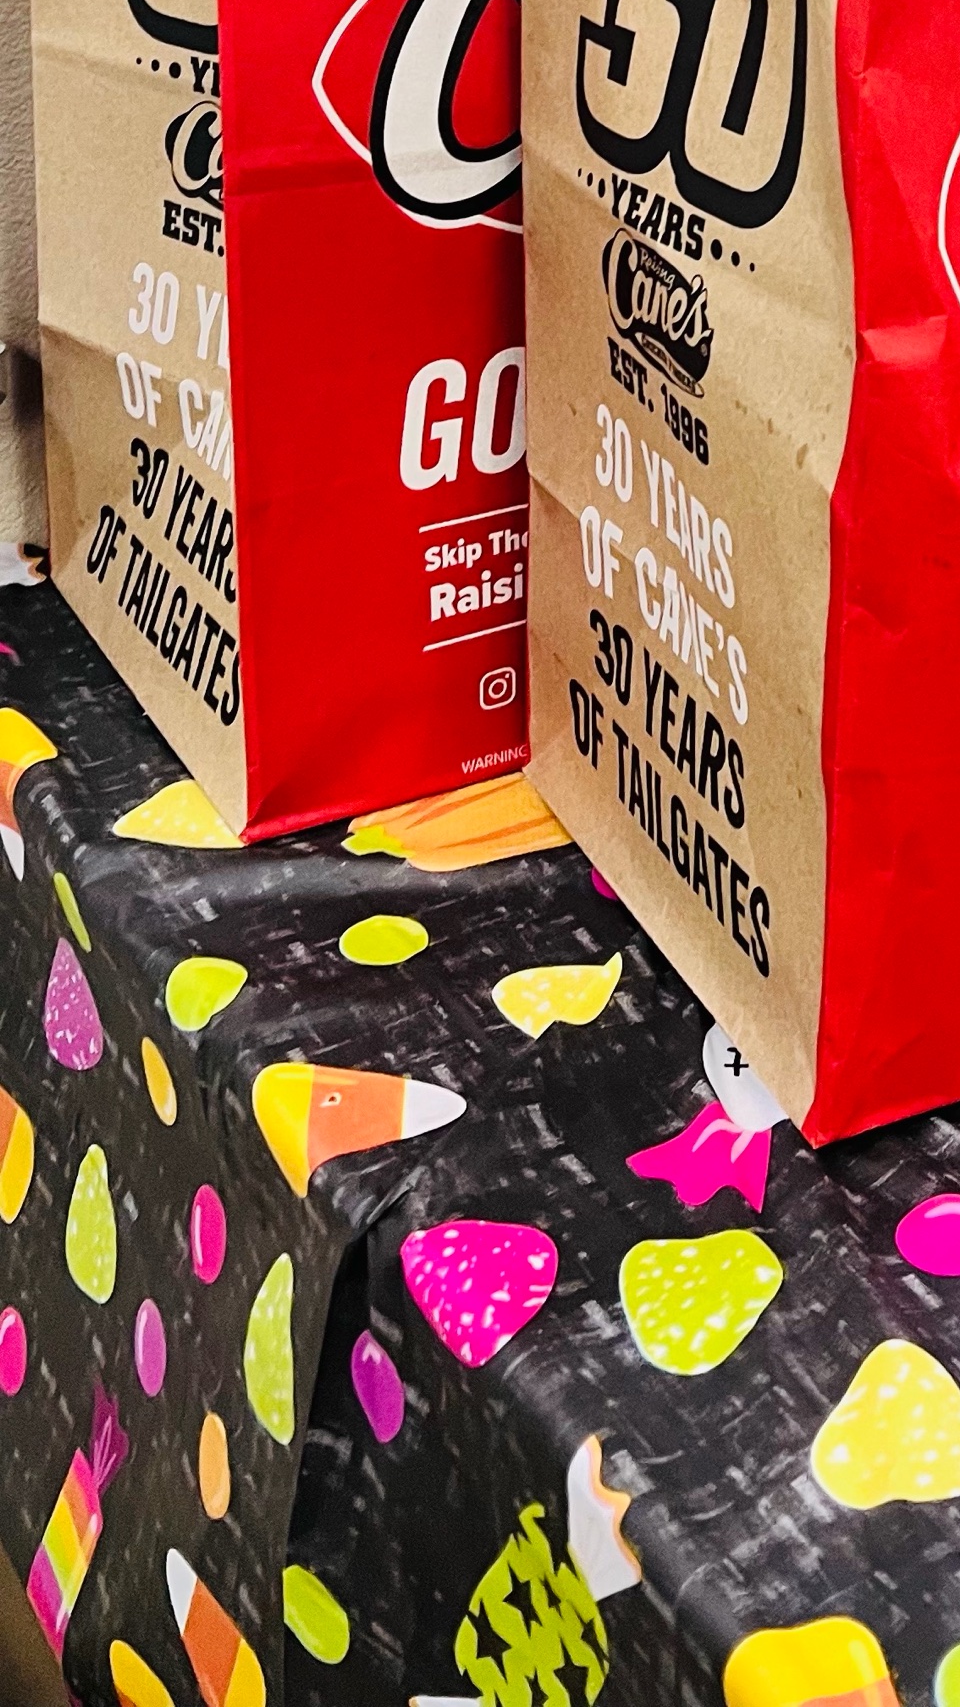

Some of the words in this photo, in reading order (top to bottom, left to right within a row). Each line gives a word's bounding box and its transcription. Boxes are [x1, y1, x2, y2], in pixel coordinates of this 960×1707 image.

[162, 200, 225, 257] EST.
[611, 173, 705, 261] YEARS
[128, 262, 180, 344] 30
[607, 228, 713, 348] Cane's
[116, 351, 162, 427] OF
[607, 337, 654, 412] EST.
[661, 383, 709, 465] 1996
[130, 437, 170, 520] 30
[595, 404, 634, 502] 30
[641, 439, 734, 608] YEARS
[86, 505, 126, 583] OF
[425, 538, 482, 573] Skip
[580, 505, 623, 598] OF
[635, 547, 748, 725] CANE'S
[589, 609, 634, 706] 30
[643, 646, 745, 830] YEARS
[570, 678, 606, 769] OF
[612, 725, 770, 978] TAILGATES
